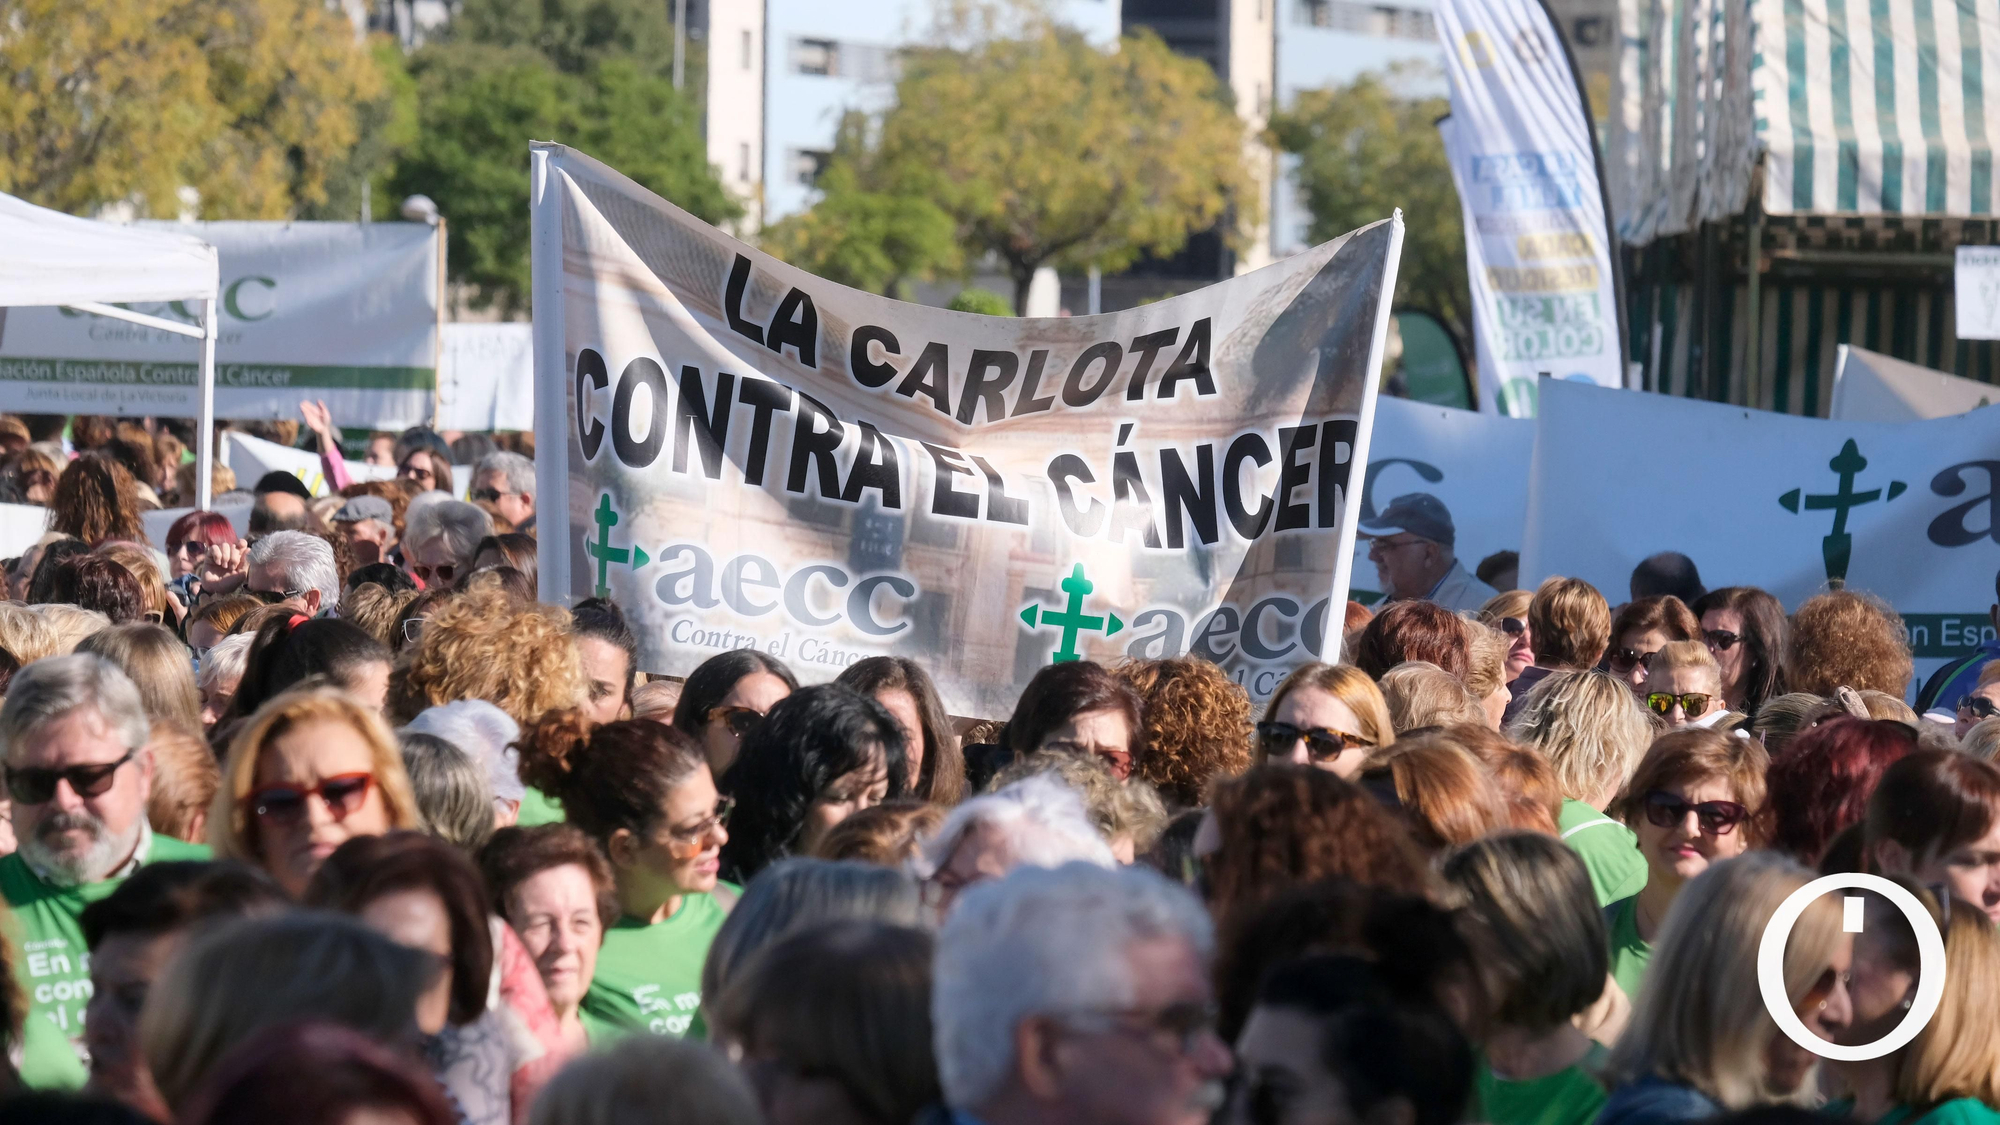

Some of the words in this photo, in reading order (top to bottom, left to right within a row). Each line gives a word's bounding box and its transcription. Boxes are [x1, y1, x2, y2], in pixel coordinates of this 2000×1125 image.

[0, 359, 51, 381] ación
[725, 252, 818, 369] LA
[850, 317, 1217, 425] CARLOTA
[576, 348, 901, 509] CONTRA
[919, 440, 1029, 526] EL
[1047, 420, 1358, 548] CÁNCER
[656, 544, 915, 636] aecc
[671, 619, 757, 650] Contra
[768, 633, 790, 657] el
[26, 951, 71, 977] En
